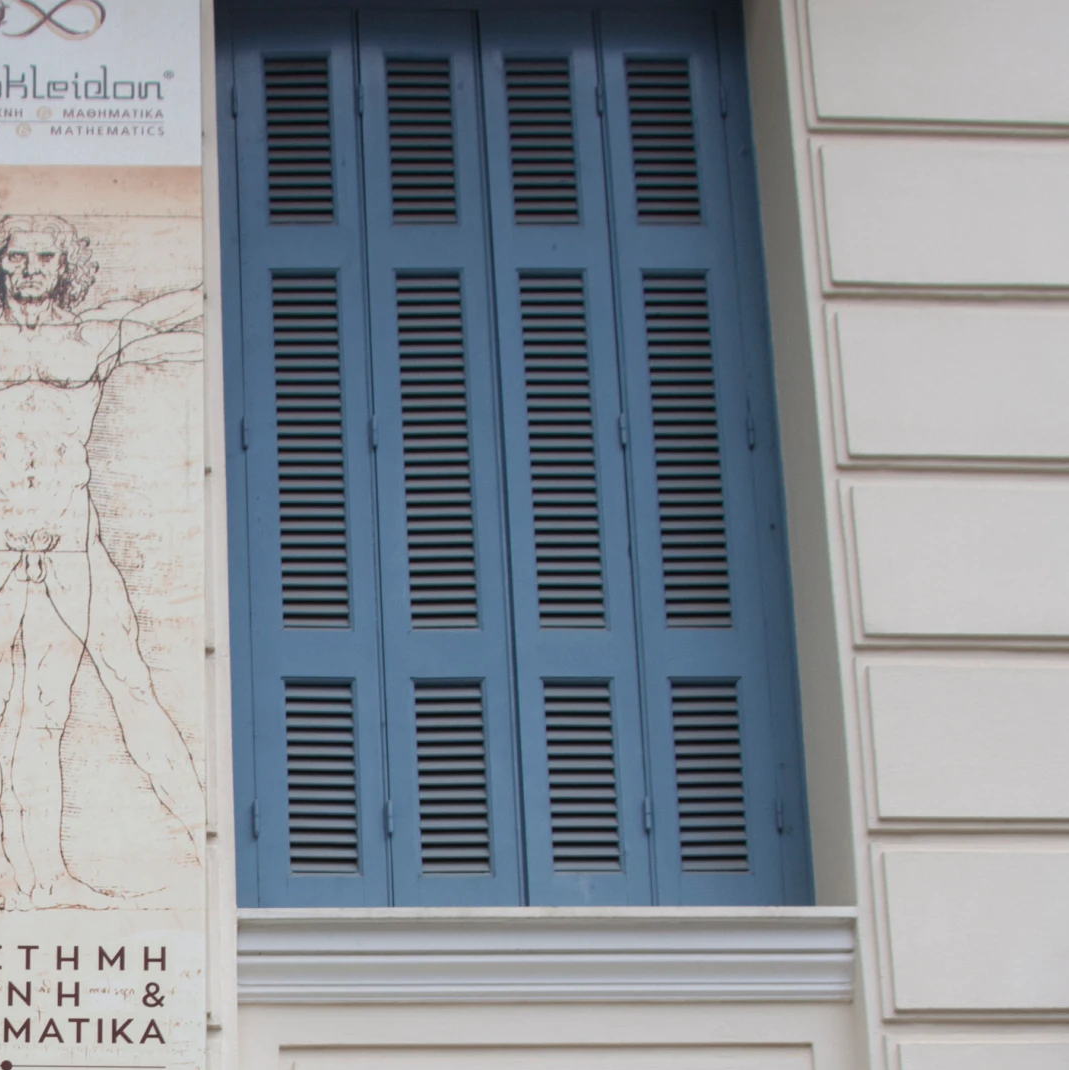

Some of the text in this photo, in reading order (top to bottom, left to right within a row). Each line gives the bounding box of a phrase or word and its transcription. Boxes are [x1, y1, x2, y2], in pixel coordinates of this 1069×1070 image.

[62, 107, 165, 119] ΜΑΘΗΜΑΤΙΚΑ
[50, 125, 165, 136] MATHEMATICS
[141, 982, 166, 1007] &
